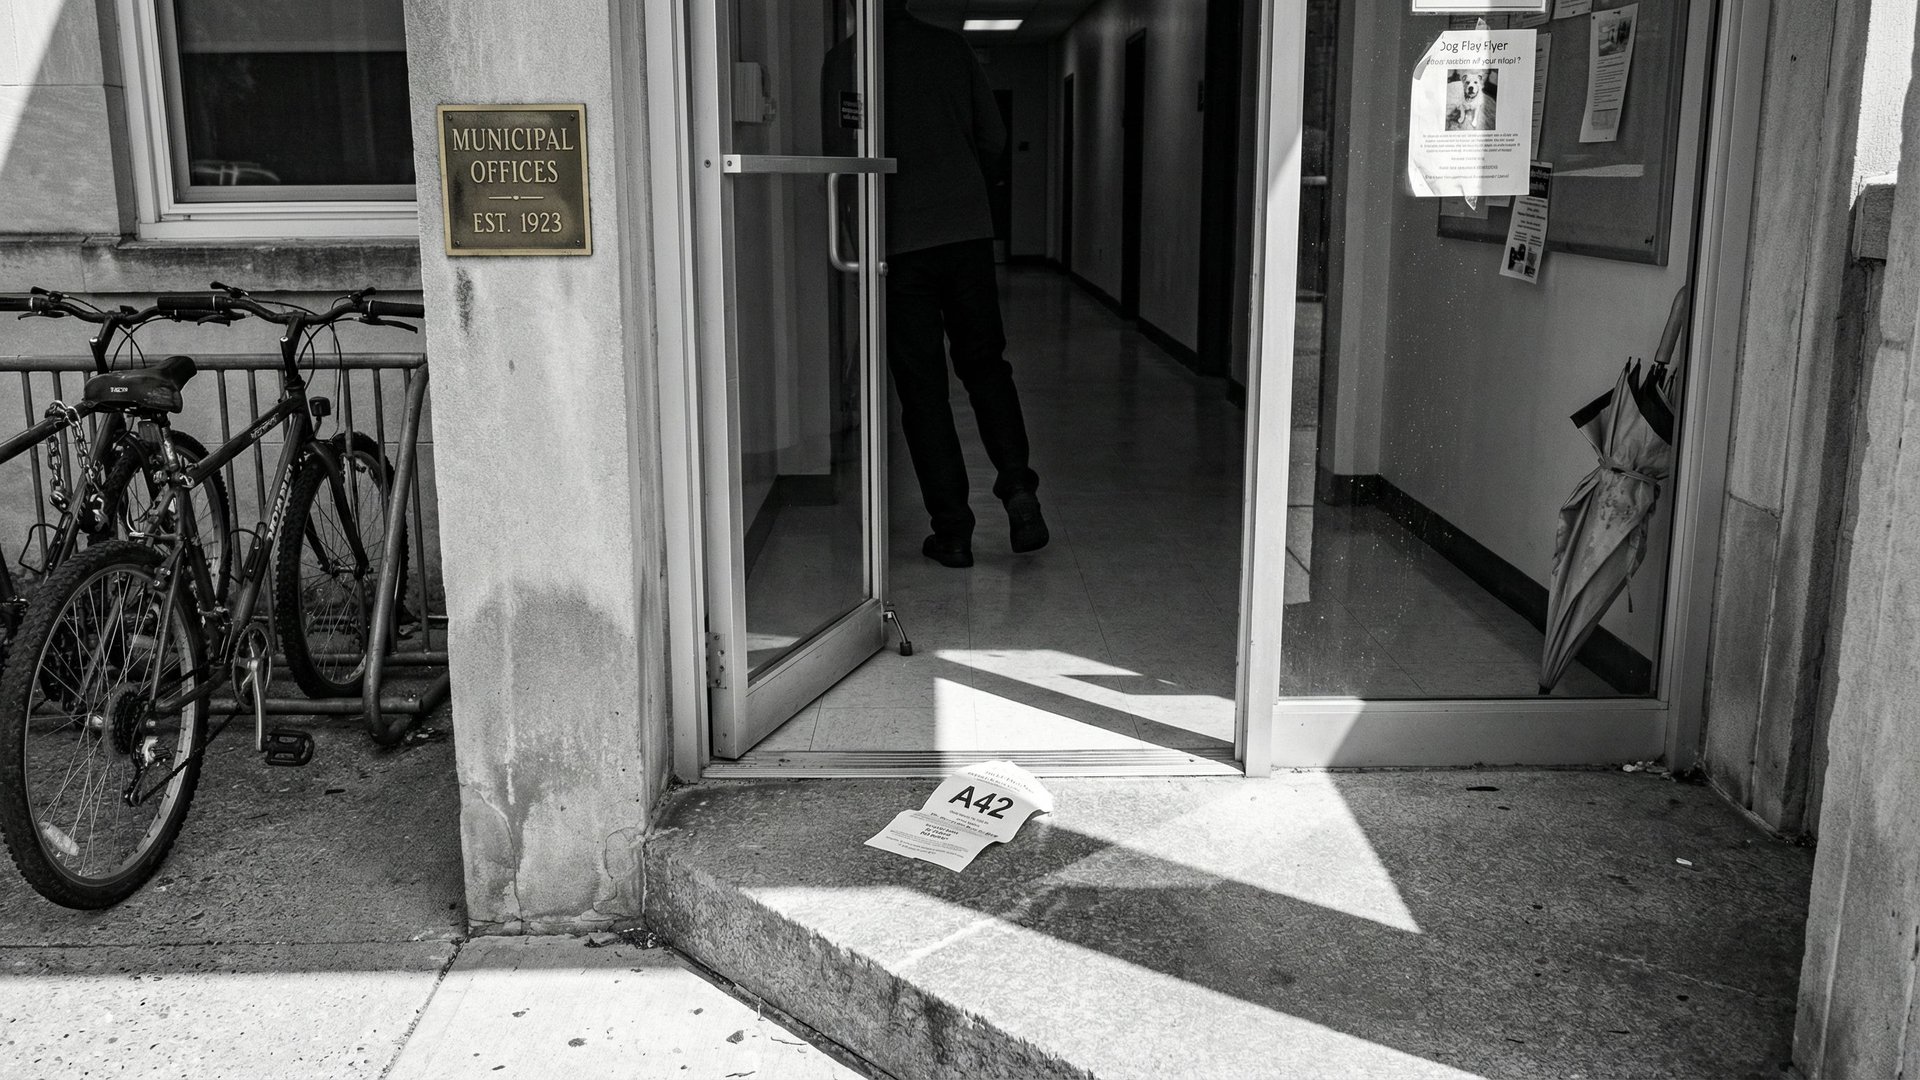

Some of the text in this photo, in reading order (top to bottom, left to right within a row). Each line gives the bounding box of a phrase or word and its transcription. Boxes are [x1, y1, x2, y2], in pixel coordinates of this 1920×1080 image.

[452, 127, 574, 151] MUNICIPAL
[470, 160, 559, 184] OFFICES
[473, 212, 562, 233] EST. 1923
[948, 785, 1014, 820] A42
